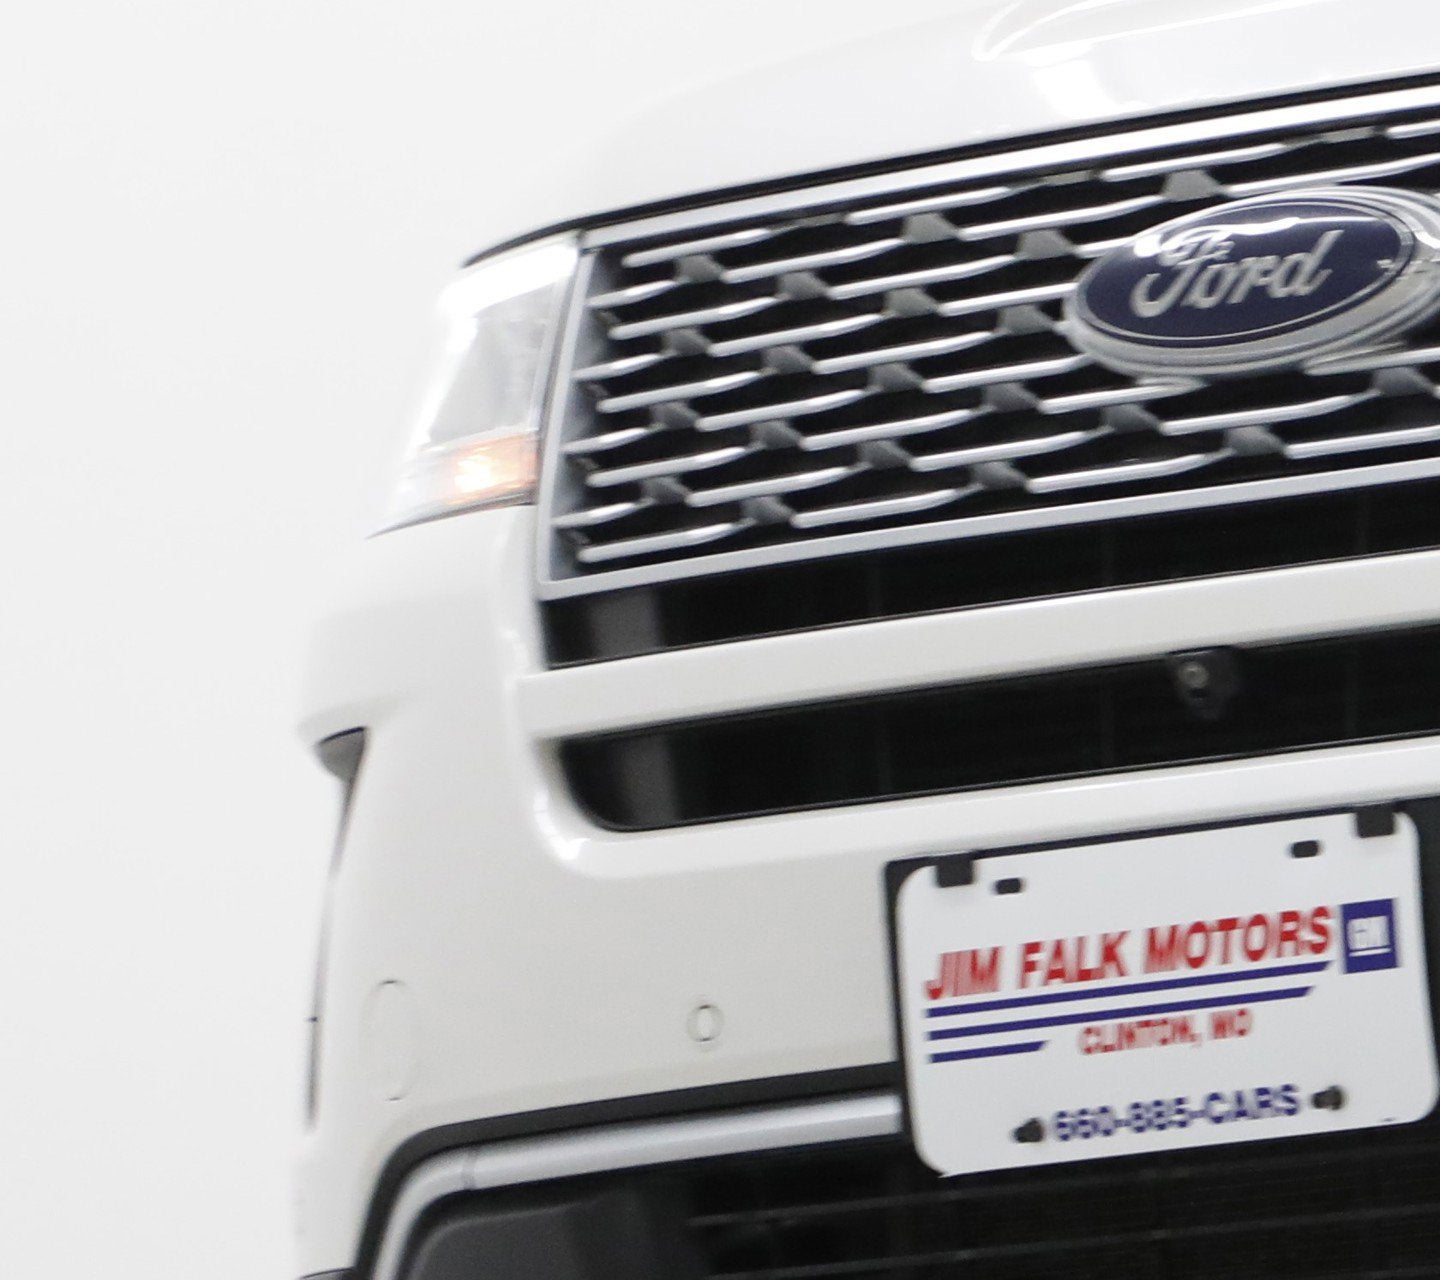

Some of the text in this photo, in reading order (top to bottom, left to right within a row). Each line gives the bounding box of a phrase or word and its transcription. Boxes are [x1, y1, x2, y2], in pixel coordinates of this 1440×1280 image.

[1130, 229, 1345, 319] Ford
[925, 905, 1333, 1001] JIM FALK MOTORS
[1080, 1008, 1254, 1056] CLINTON, MO
[1055, 1084, 1300, 1142] 660-885-CARS
